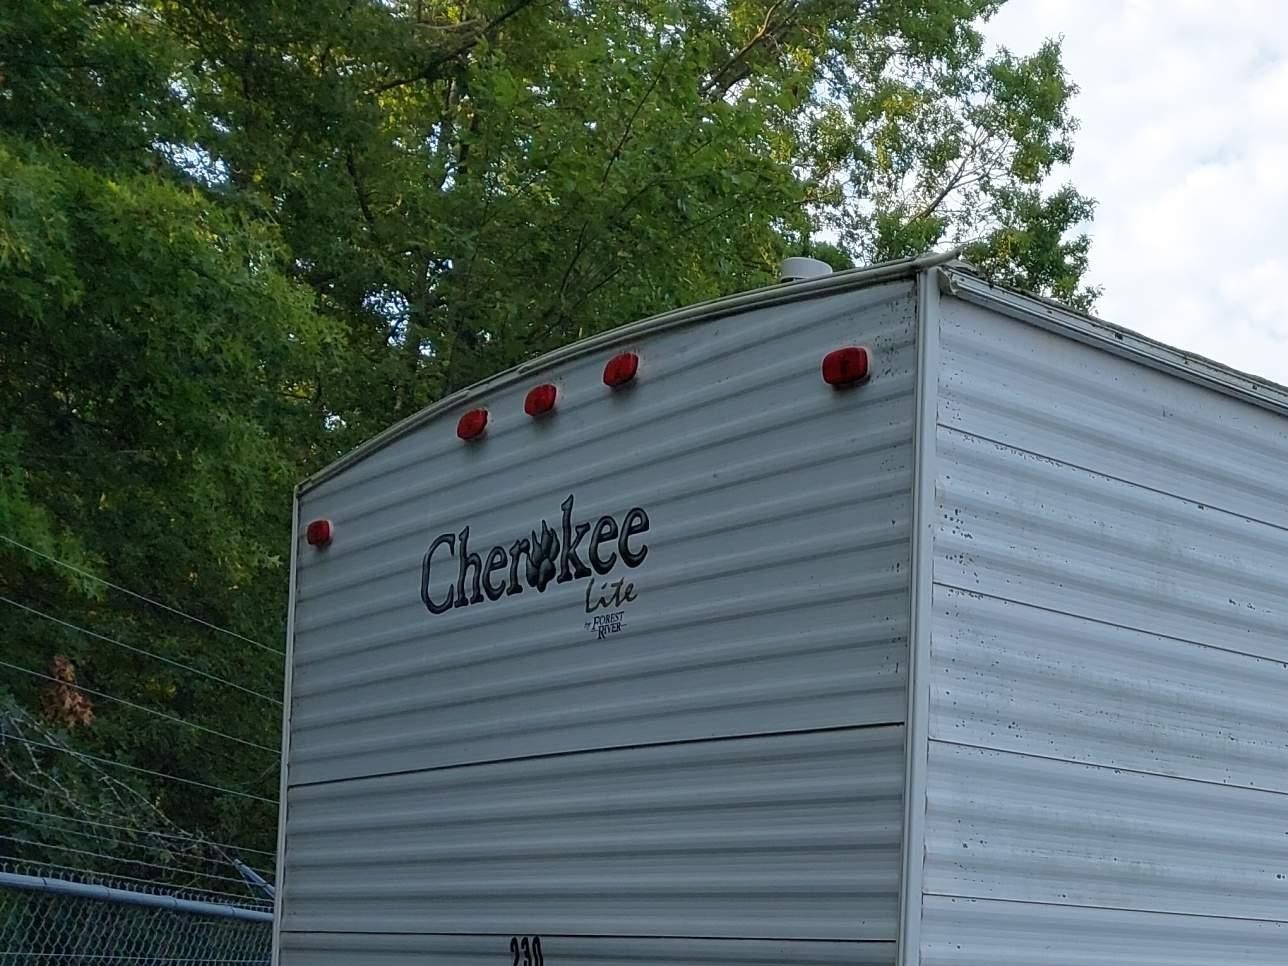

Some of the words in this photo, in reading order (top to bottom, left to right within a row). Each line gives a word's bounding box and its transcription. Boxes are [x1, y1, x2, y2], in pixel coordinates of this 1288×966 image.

[420, 494, 650, 615] Cherokee
[585, 577, 638, 614] Lite
[592, 611, 625, 630] FOREST
[597, 622, 622, 640] RIVER
